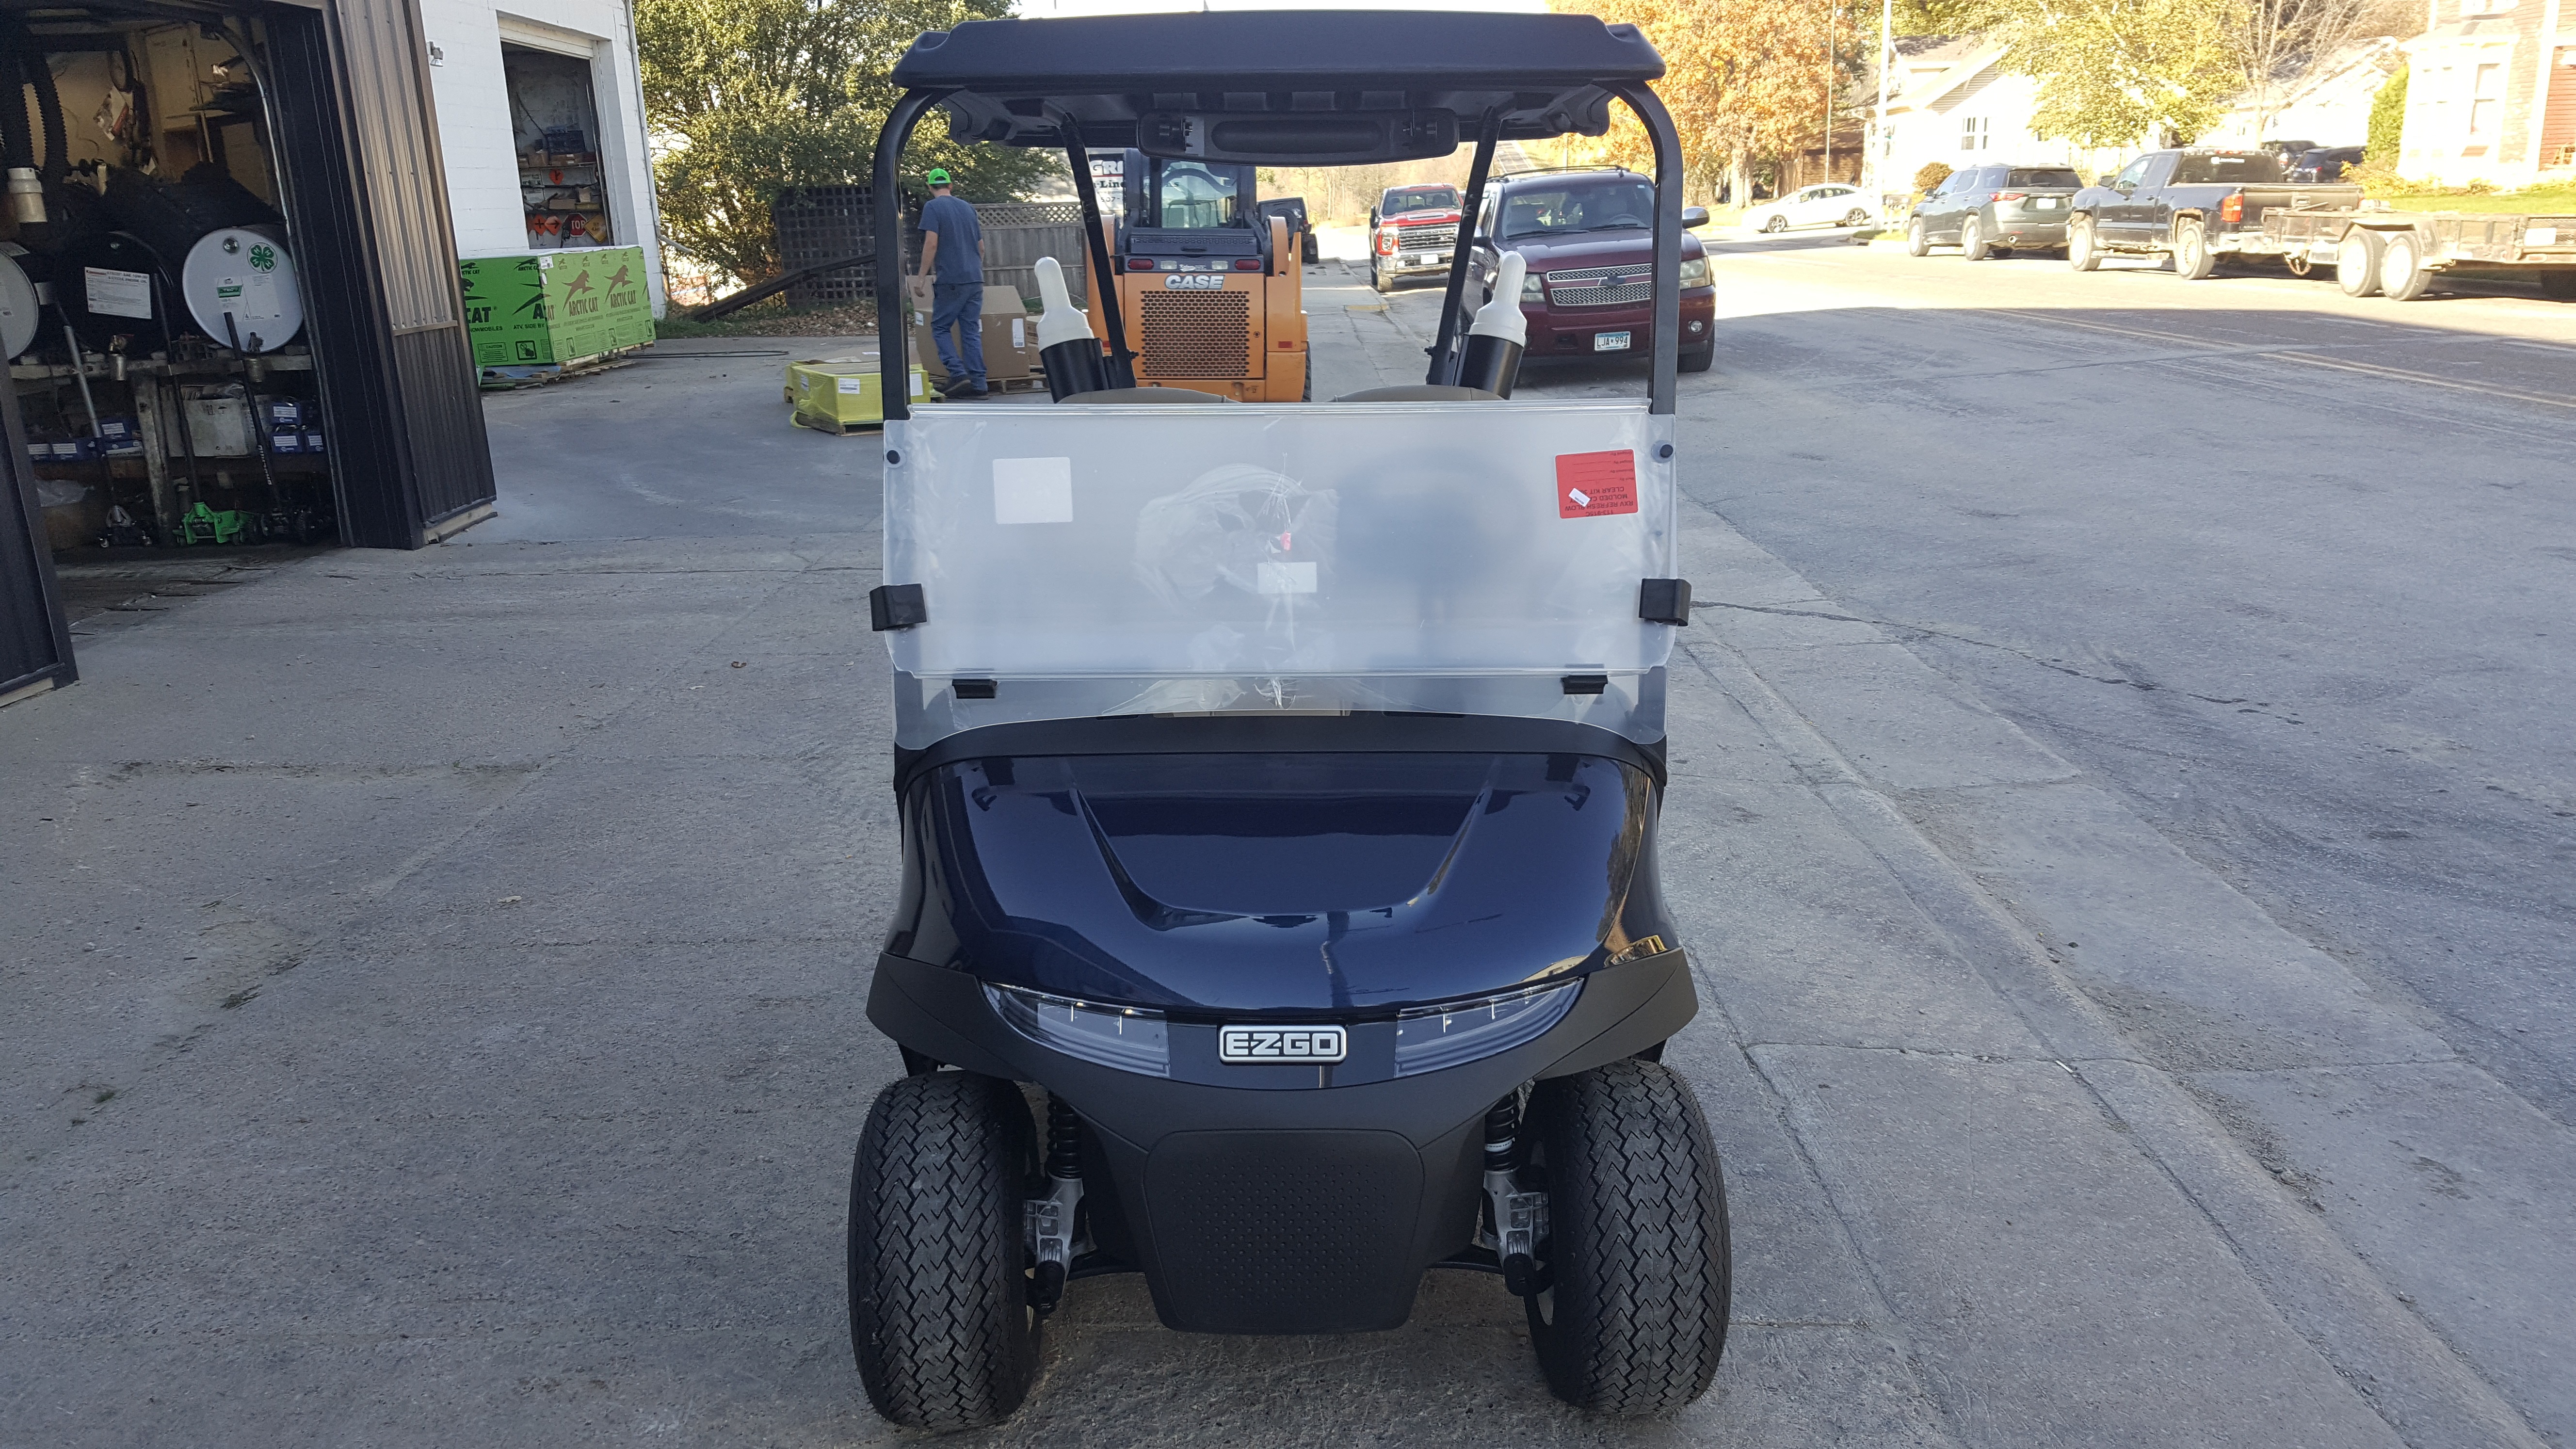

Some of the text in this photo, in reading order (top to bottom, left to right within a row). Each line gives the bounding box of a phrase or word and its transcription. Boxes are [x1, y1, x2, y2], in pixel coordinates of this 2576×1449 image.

[571, 220, 585, 229] TOP
[1165, 274, 1224, 289] CASE
[611, 290, 636, 308] ARCTIC CAT
[569, 298, 588, 317] ARCTIC
[589, 297, 598, 312] CAT
[1597, 336, 1628, 346] LJA 994
